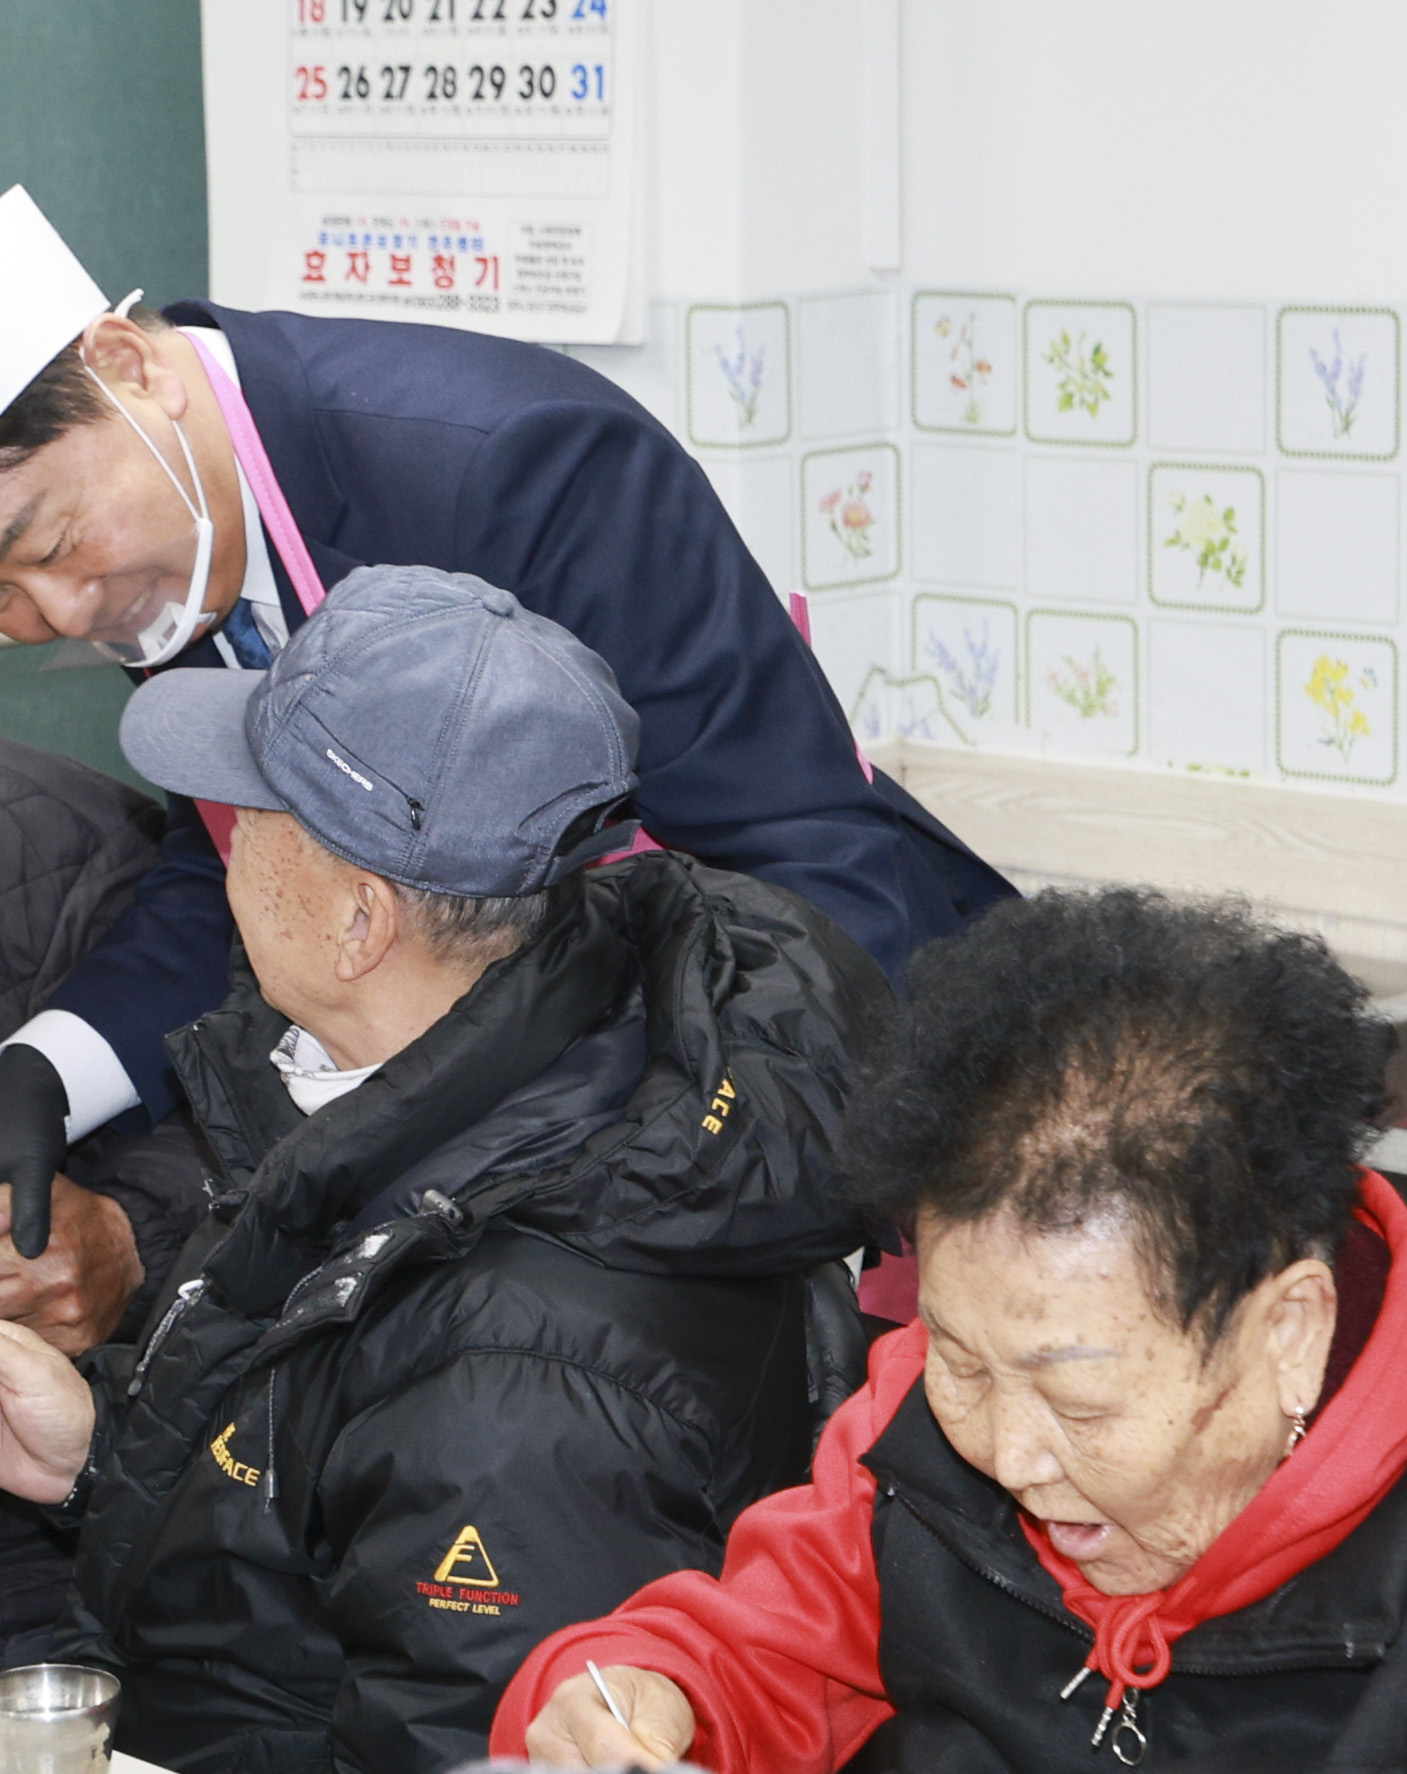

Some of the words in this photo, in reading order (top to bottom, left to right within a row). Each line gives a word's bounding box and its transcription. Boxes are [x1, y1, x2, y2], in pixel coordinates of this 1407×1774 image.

[296, 0, 326, 23] 18
[340, 0, 368, 23] 19
[383, 0, 413, 22] 20
[429, 0, 455, 22] 21
[471, 0, 505, 21] 22
[522, 0, 557, 19] 23
[572, 0, 608, 18] 24
[295, 67, 328, 101] 25
[338, 66, 370, 100] 26
[381, 66, 412, 100] 27
[425, 66, 458, 100] 28
[469, 66, 506, 100] 29
[519, 66, 556, 99] 30
[571, 64, 604, 99] 31
[301, 248, 501, 292] 효자보청기
[415, 1581, 455, 1600] TRIPLE
[458, 1587, 521, 1606] FUNCTION
[428, 1597, 471, 1613] PERFECT
[472, 1603, 501, 1616] LEVEL
